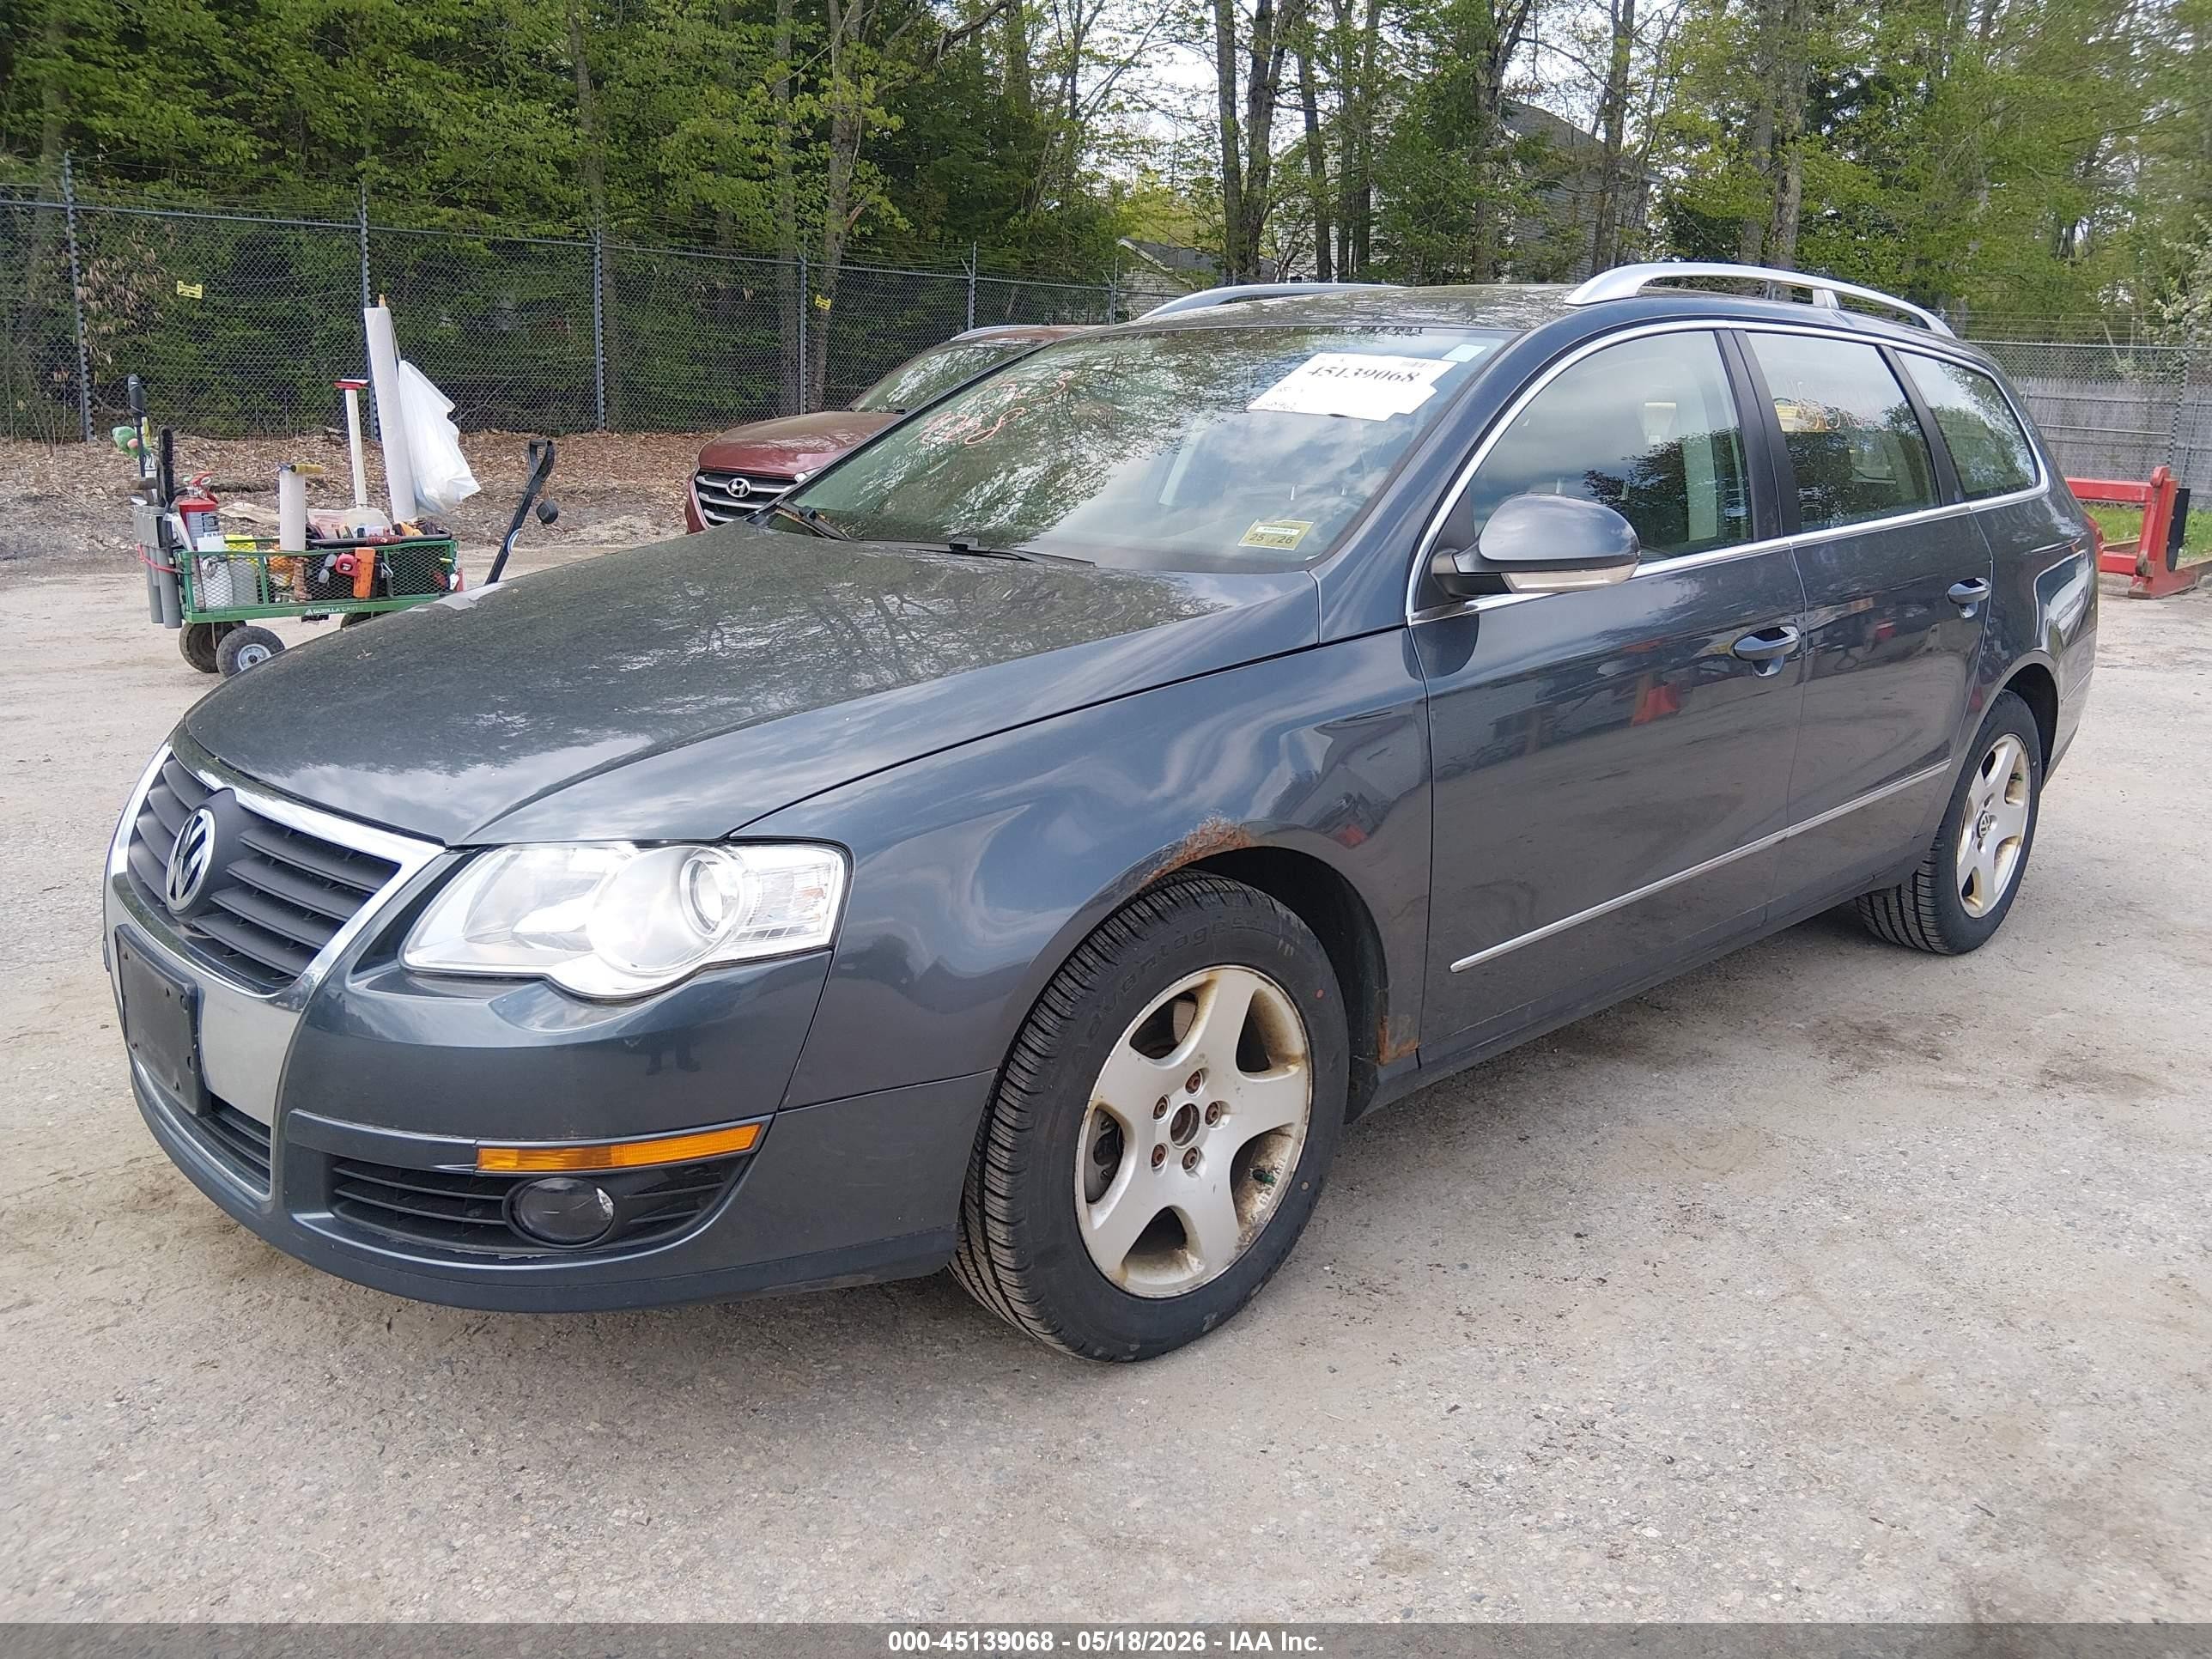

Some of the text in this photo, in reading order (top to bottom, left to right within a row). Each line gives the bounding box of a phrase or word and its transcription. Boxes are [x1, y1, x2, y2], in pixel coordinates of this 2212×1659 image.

[1307, 365, 1420, 383] 45139068
[1249, 533, 1295, 544] 25 26
